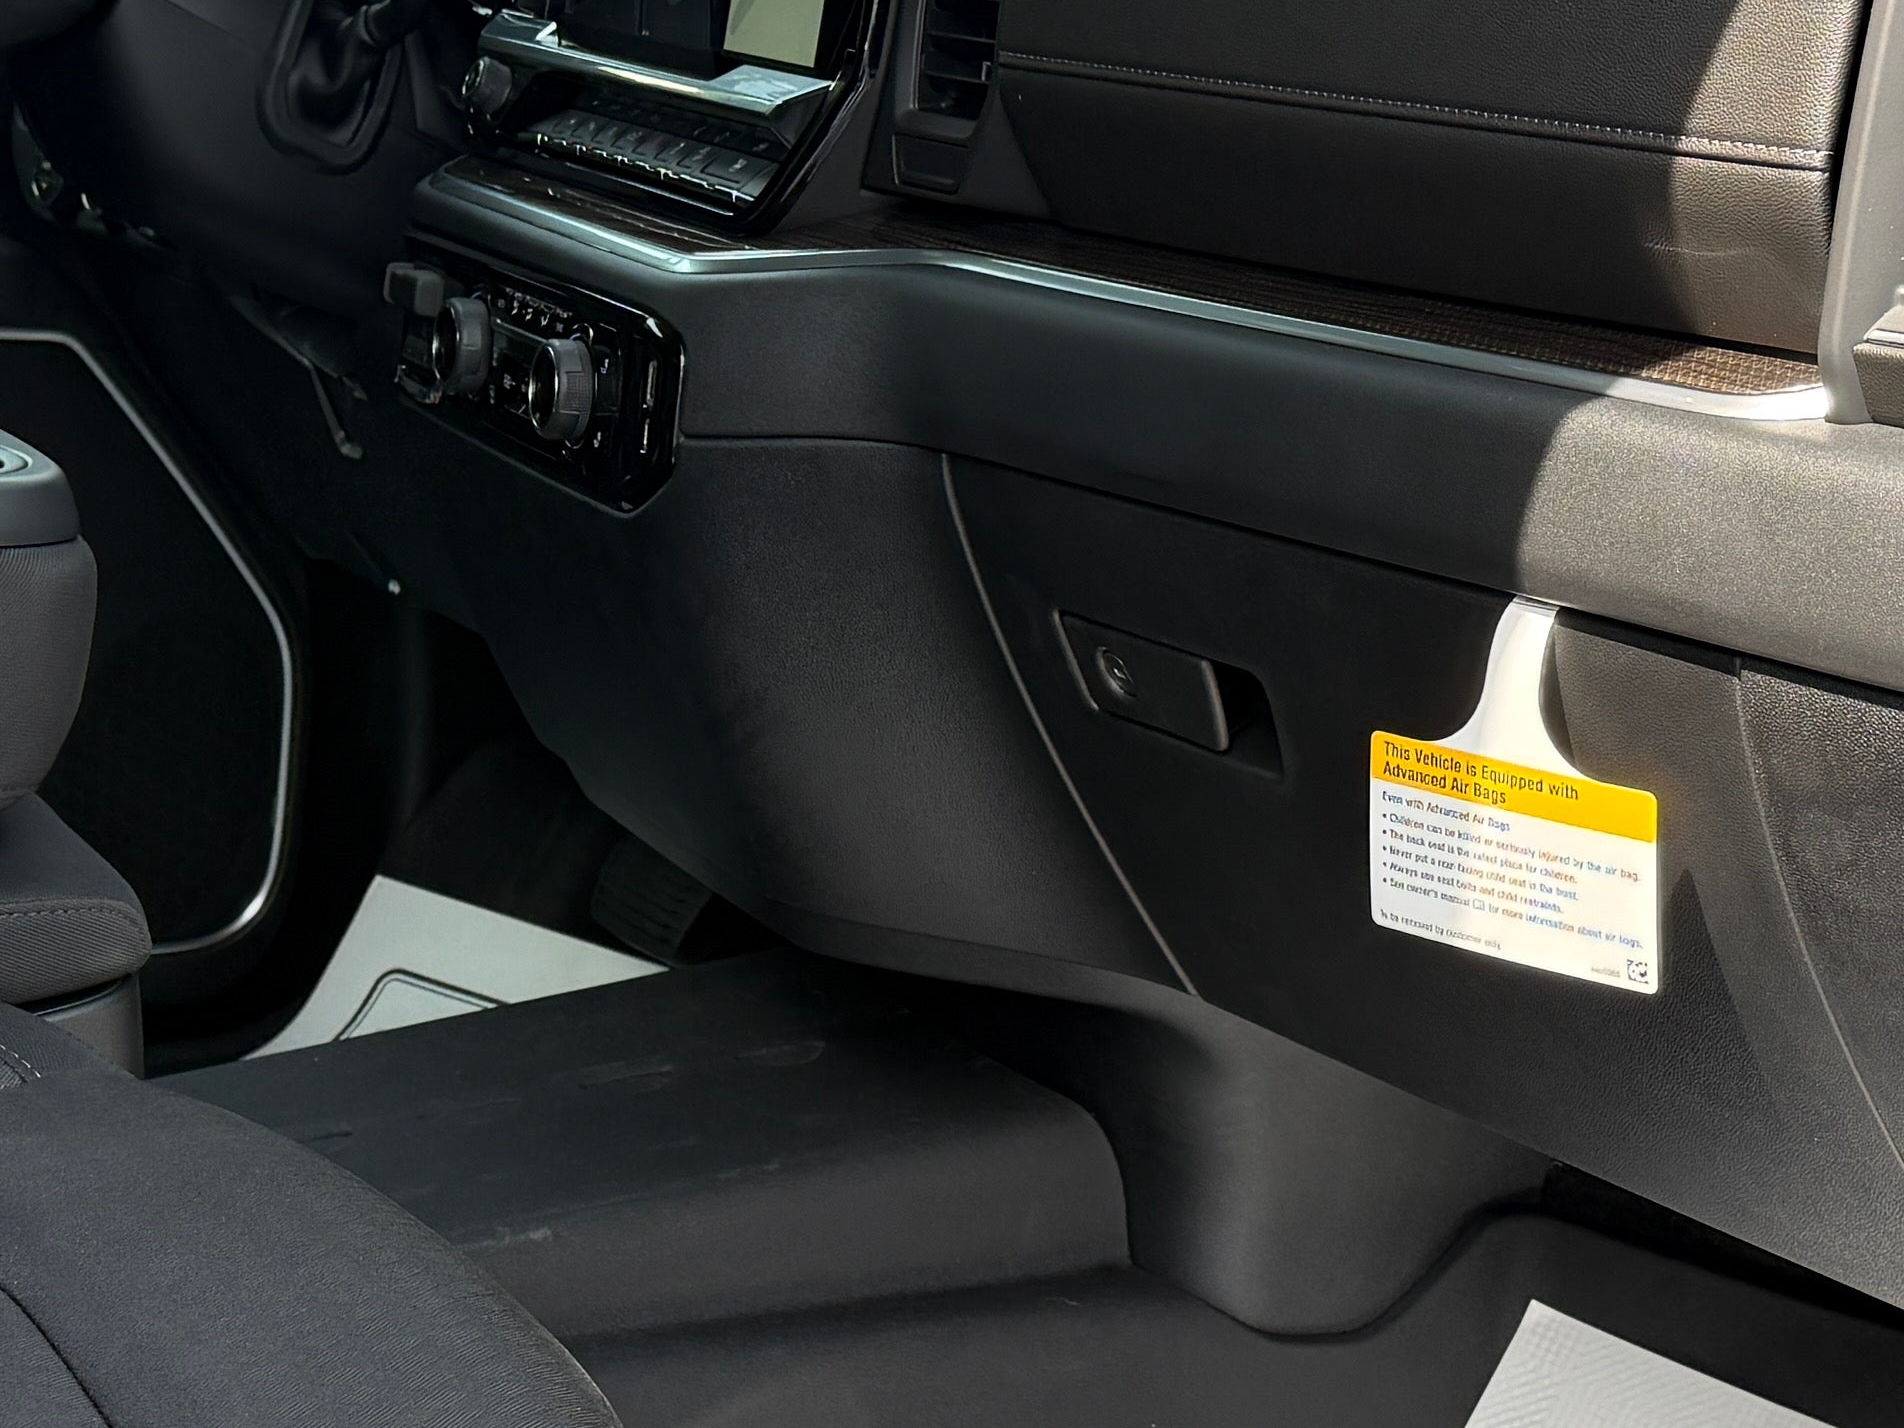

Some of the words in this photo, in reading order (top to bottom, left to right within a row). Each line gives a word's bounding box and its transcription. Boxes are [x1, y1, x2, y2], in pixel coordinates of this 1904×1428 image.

[1383, 761, 1447, 789] Advanced
[1450, 777, 1469, 794] Air
[1473, 783, 1507, 805] Bags
[1384, 741, 1410, 761] This
[1415, 749, 1462, 772] Vehicle
[1466, 761, 1477, 777] is
[1482, 766, 1544, 794] Equipped
[1549, 782, 1579, 801] with
